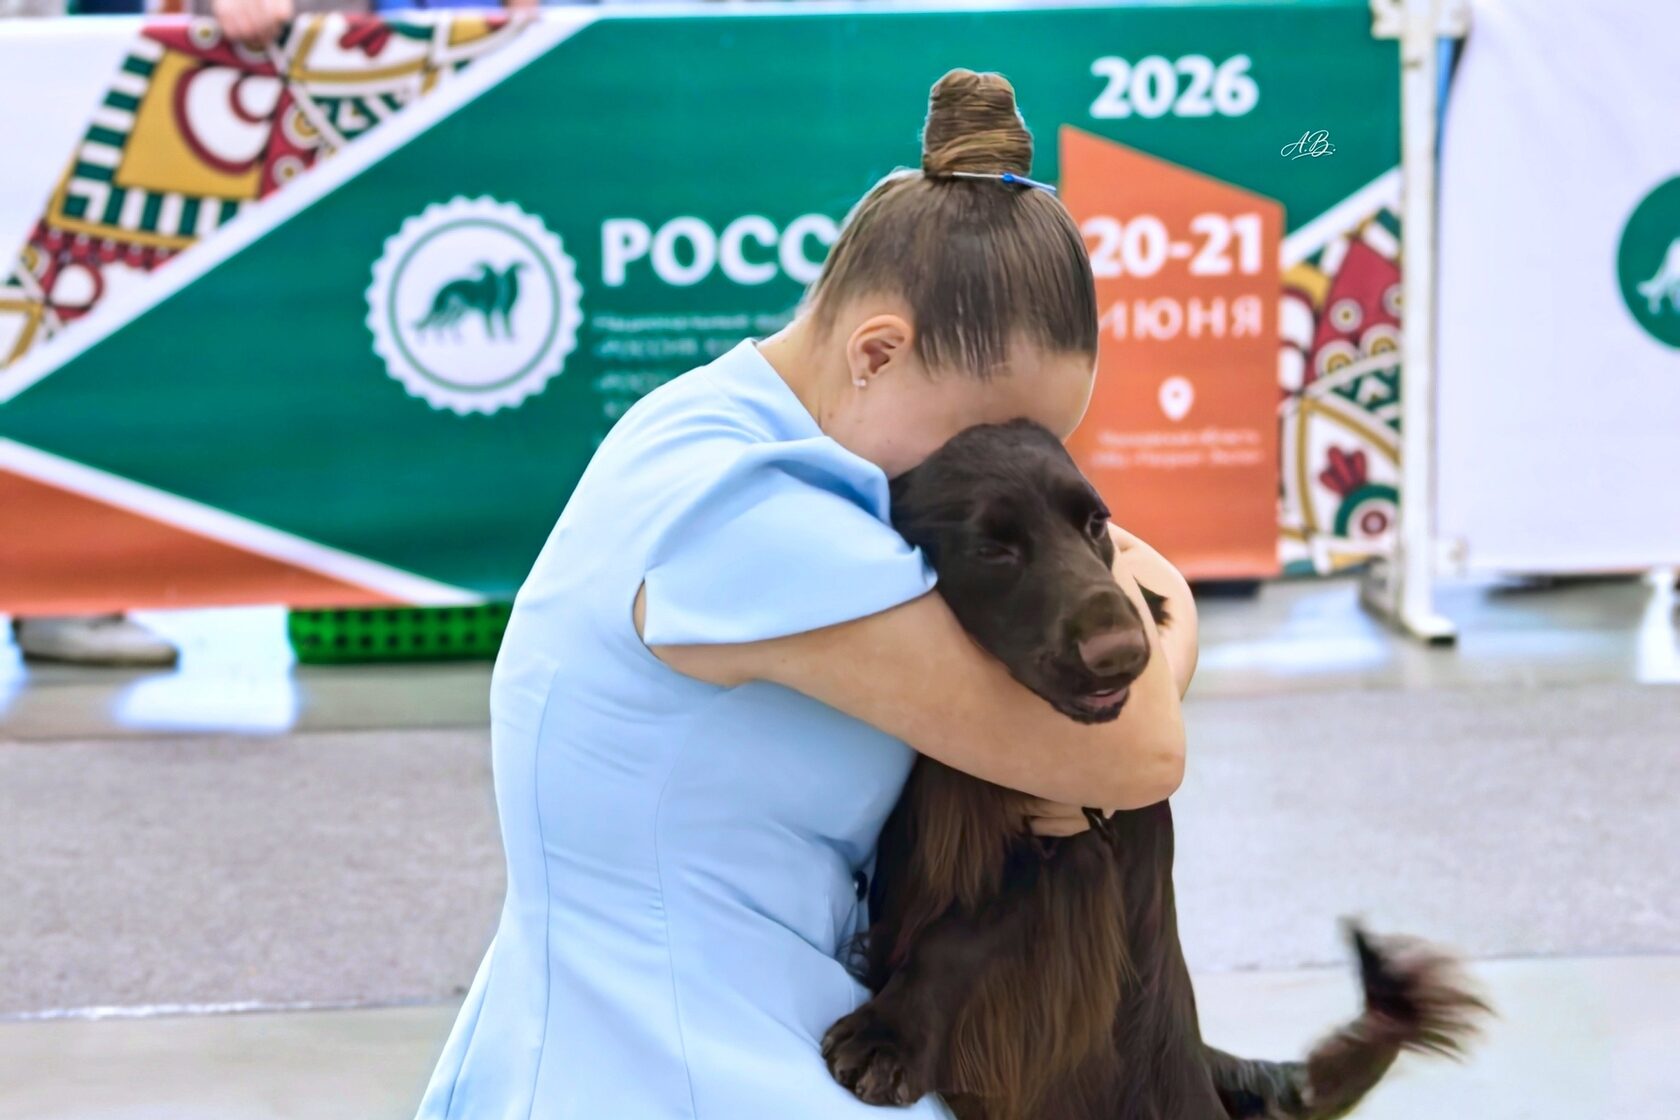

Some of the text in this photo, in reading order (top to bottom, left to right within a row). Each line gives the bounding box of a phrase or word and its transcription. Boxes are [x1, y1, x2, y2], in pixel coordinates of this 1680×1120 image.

[1089, 54, 1260, 119] 2026
[602, 213, 838, 286] РОСС
[1081, 213, 1262, 278] 20-21
